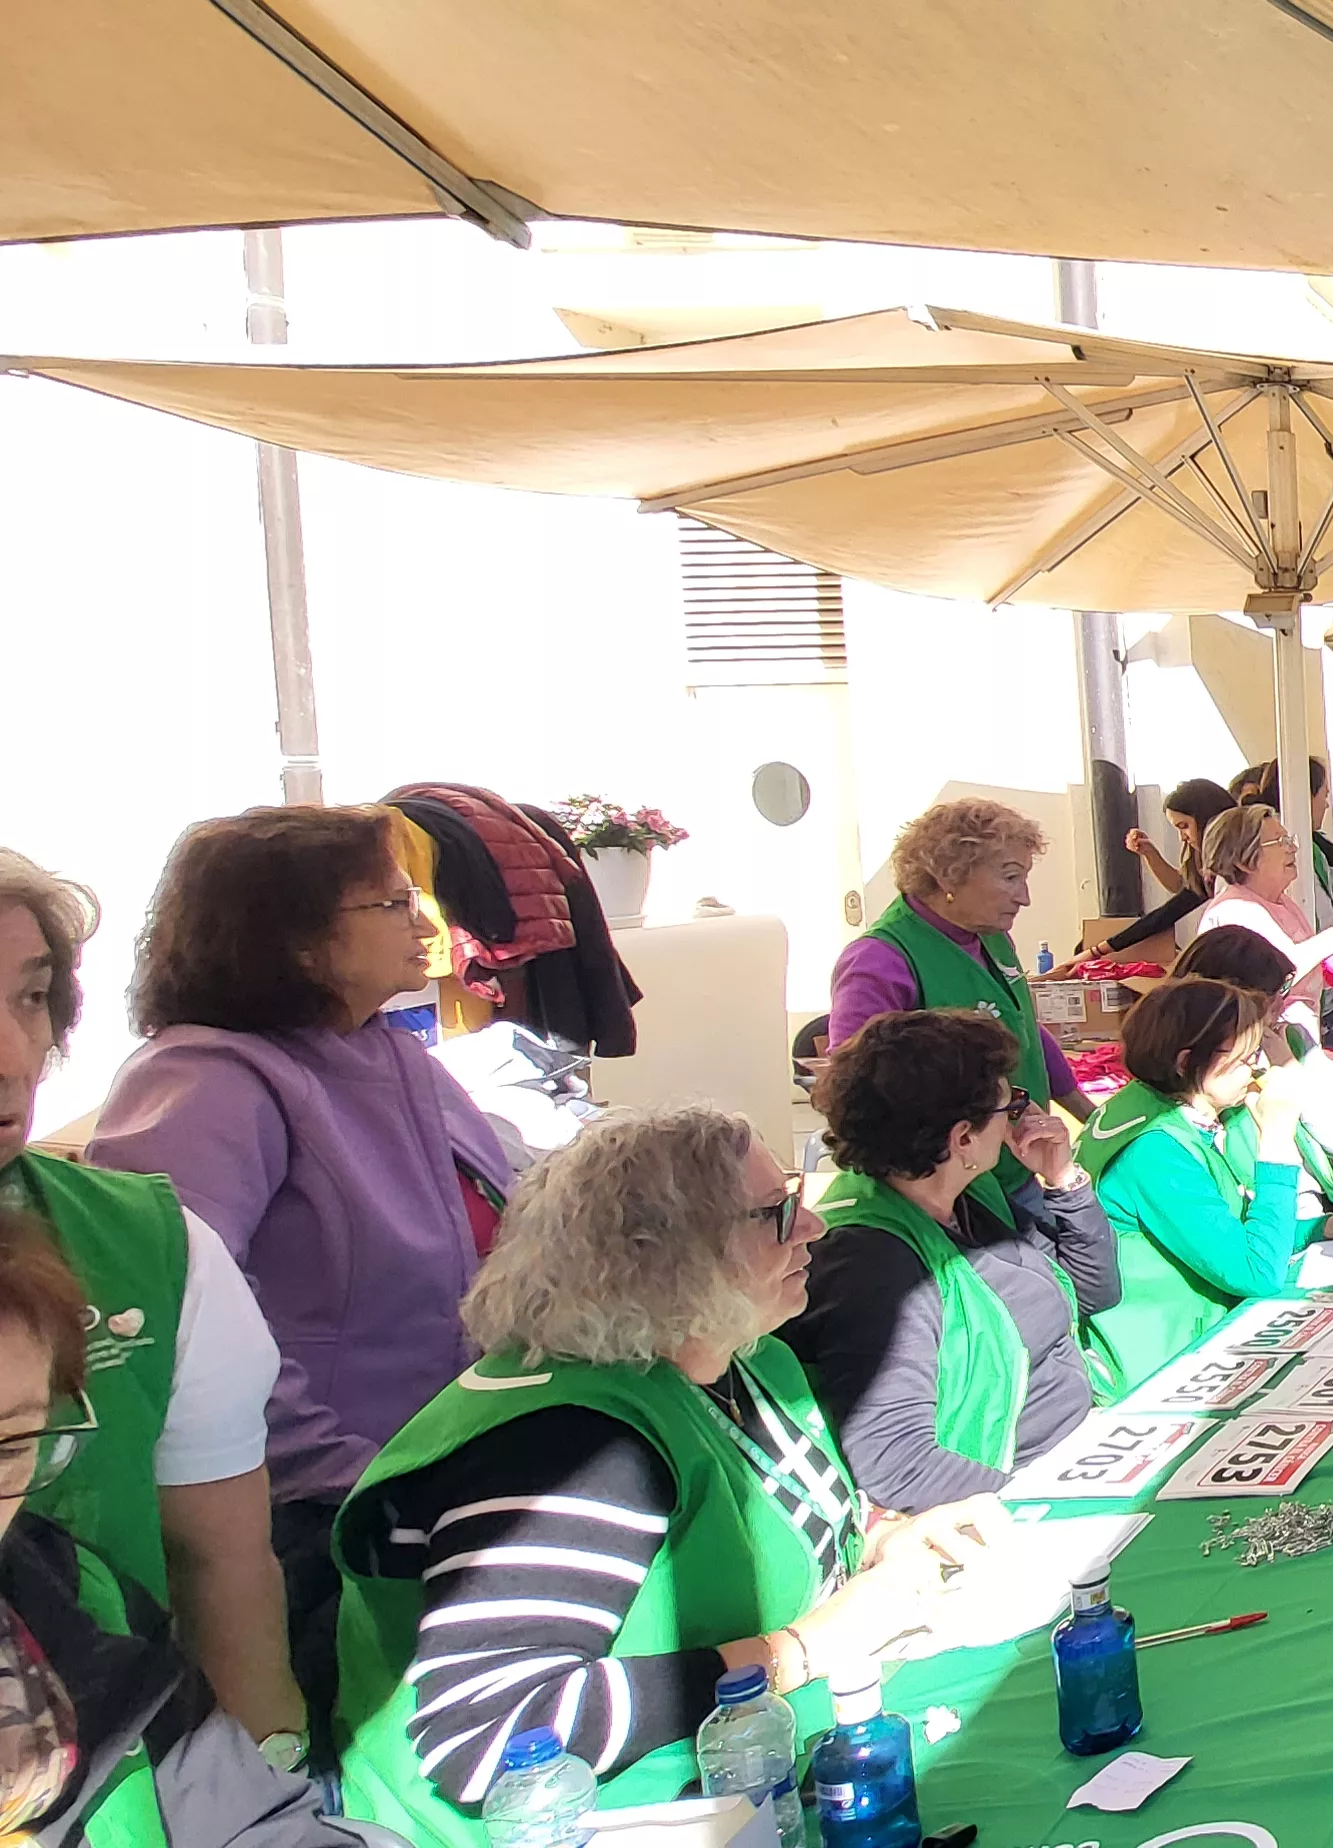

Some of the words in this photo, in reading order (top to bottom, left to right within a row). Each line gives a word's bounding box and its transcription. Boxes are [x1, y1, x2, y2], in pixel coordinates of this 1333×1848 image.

[1241, 1308, 1317, 1348] 2500
[1161, 1361, 1246, 1404] 2550
[1057, 1425, 1157, 1482] 2703
[1210, 1424, 1306, 1484] 2753
